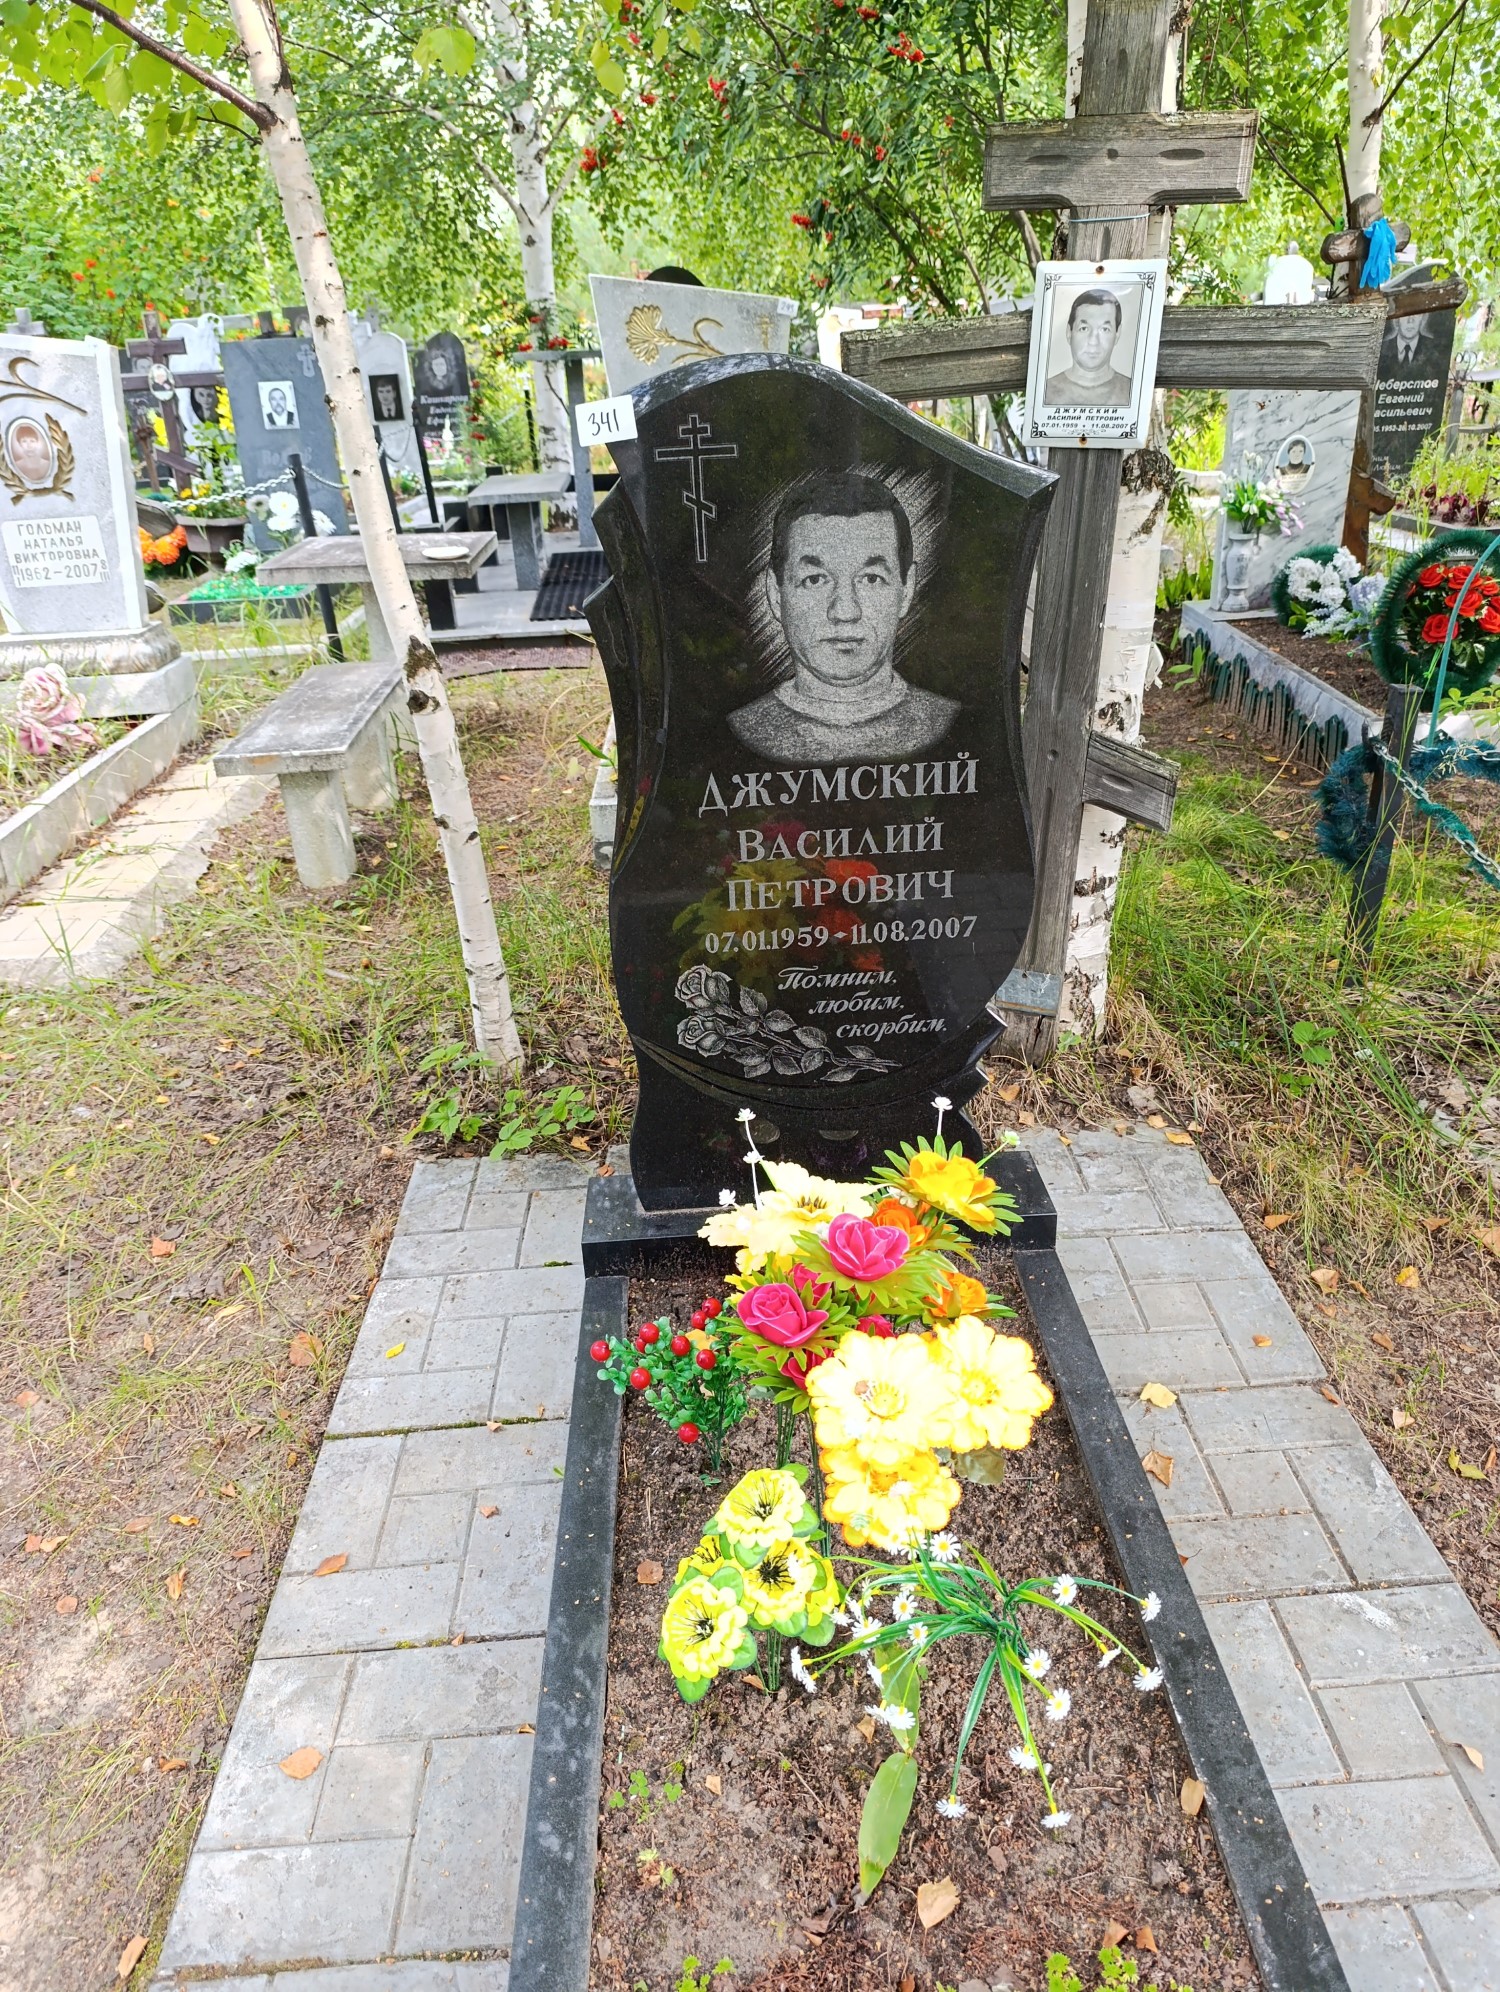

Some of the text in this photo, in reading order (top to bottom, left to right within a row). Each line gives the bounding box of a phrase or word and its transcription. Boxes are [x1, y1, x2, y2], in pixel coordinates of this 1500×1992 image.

[1377, 391, 1425, 405] Евгений
[587, 408, 620, 437] 341
[1373, 407, 1433, 418] асильевич
[17, 520, 82, 537] ГОЛЬМАН
[23, 535, 84, 550] НАТАЛЬЯ
[13, 548, 100, 564] ВИКТОРОВНА
[698, 751, 980, 818] ДЖУМСКИЙ
[736, 816, 945, 863] ВАСИЛИЙ
[725, 869, 955, 912] ПЕТРОВИЧ
[836, 1012, 948, 1042] скорбим.
